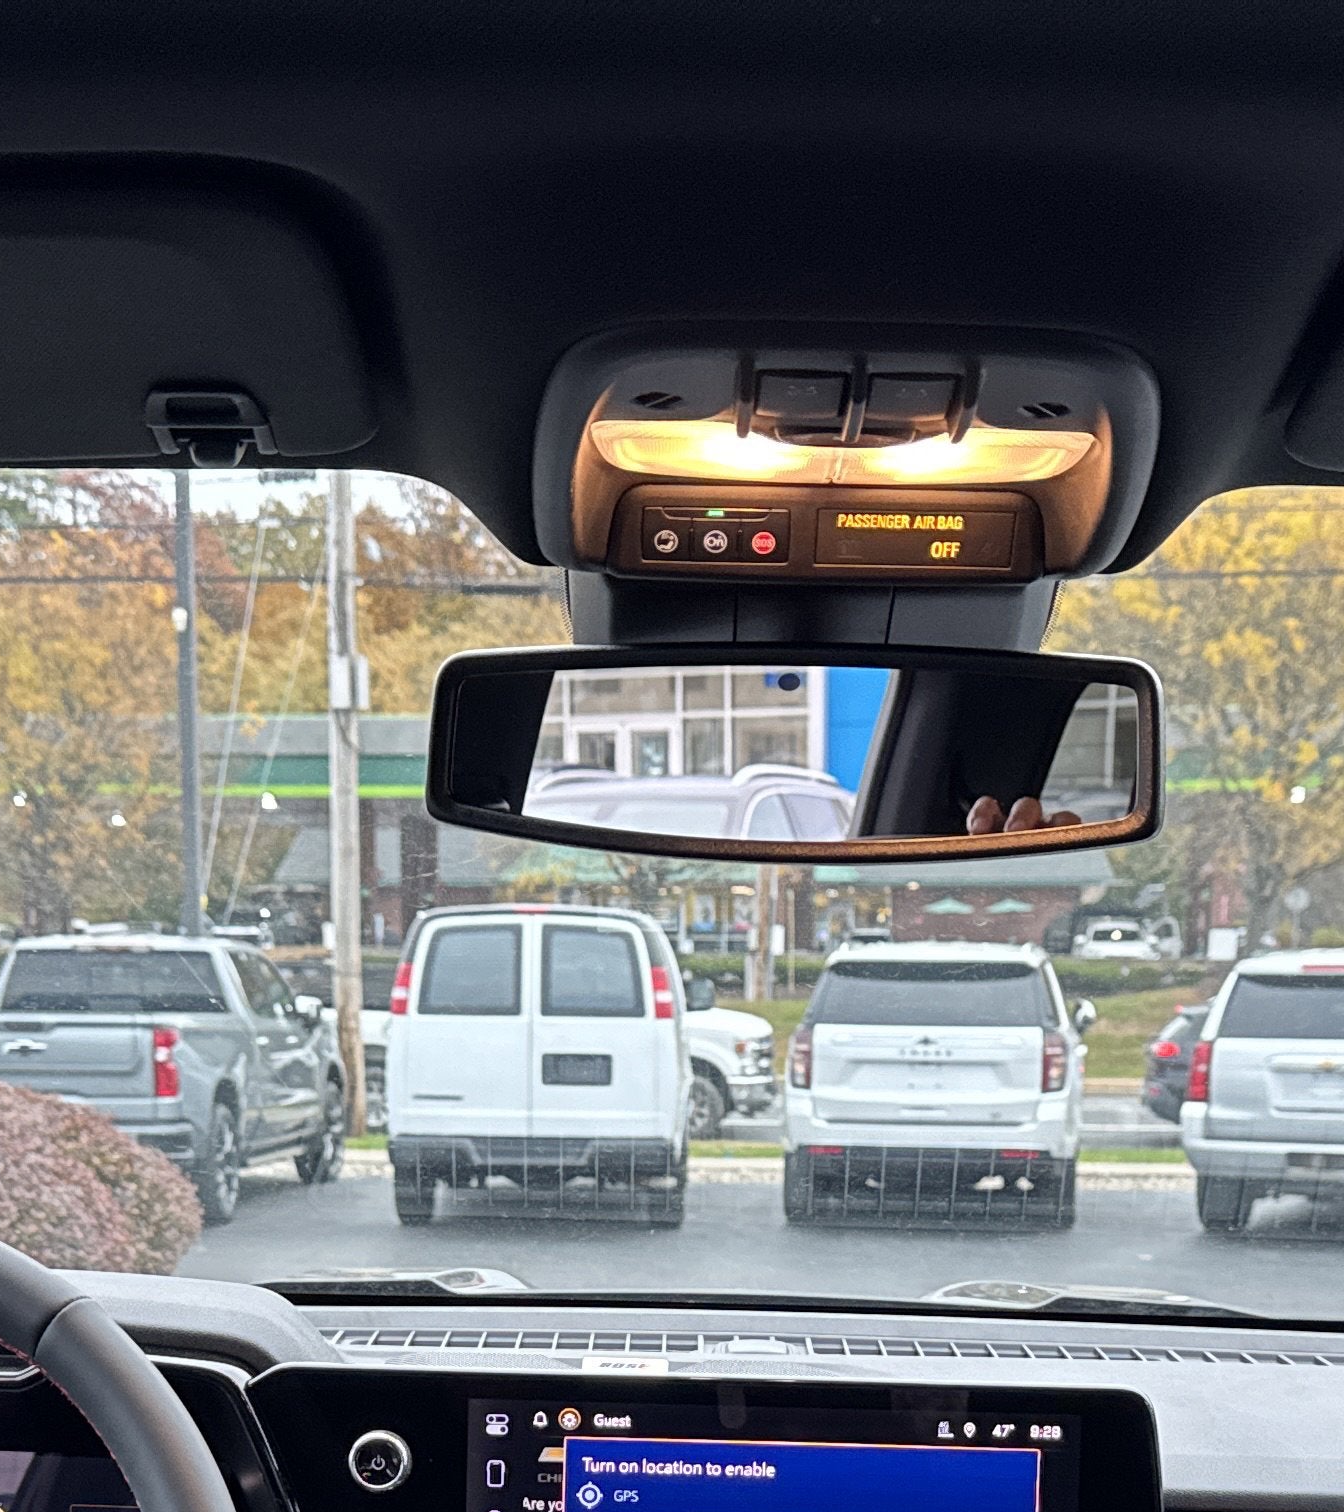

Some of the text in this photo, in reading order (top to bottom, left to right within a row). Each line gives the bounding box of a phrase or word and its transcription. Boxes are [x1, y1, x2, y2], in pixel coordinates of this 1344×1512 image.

[837, 513, 964, 531] PASSENGER AIR BAG
[753, 536, 775, 549] SOS
[930, 541, 961, 559] OFF
[593, 1413, 632, 1428] Guest
[991, 1423, 1016, 1438] 47°
[1029, 1424, 1062, 1440] 9:28
[581, 1457, 776, 1478] Turn on location to enable
[613, 1489, 639, 1503] GPS
